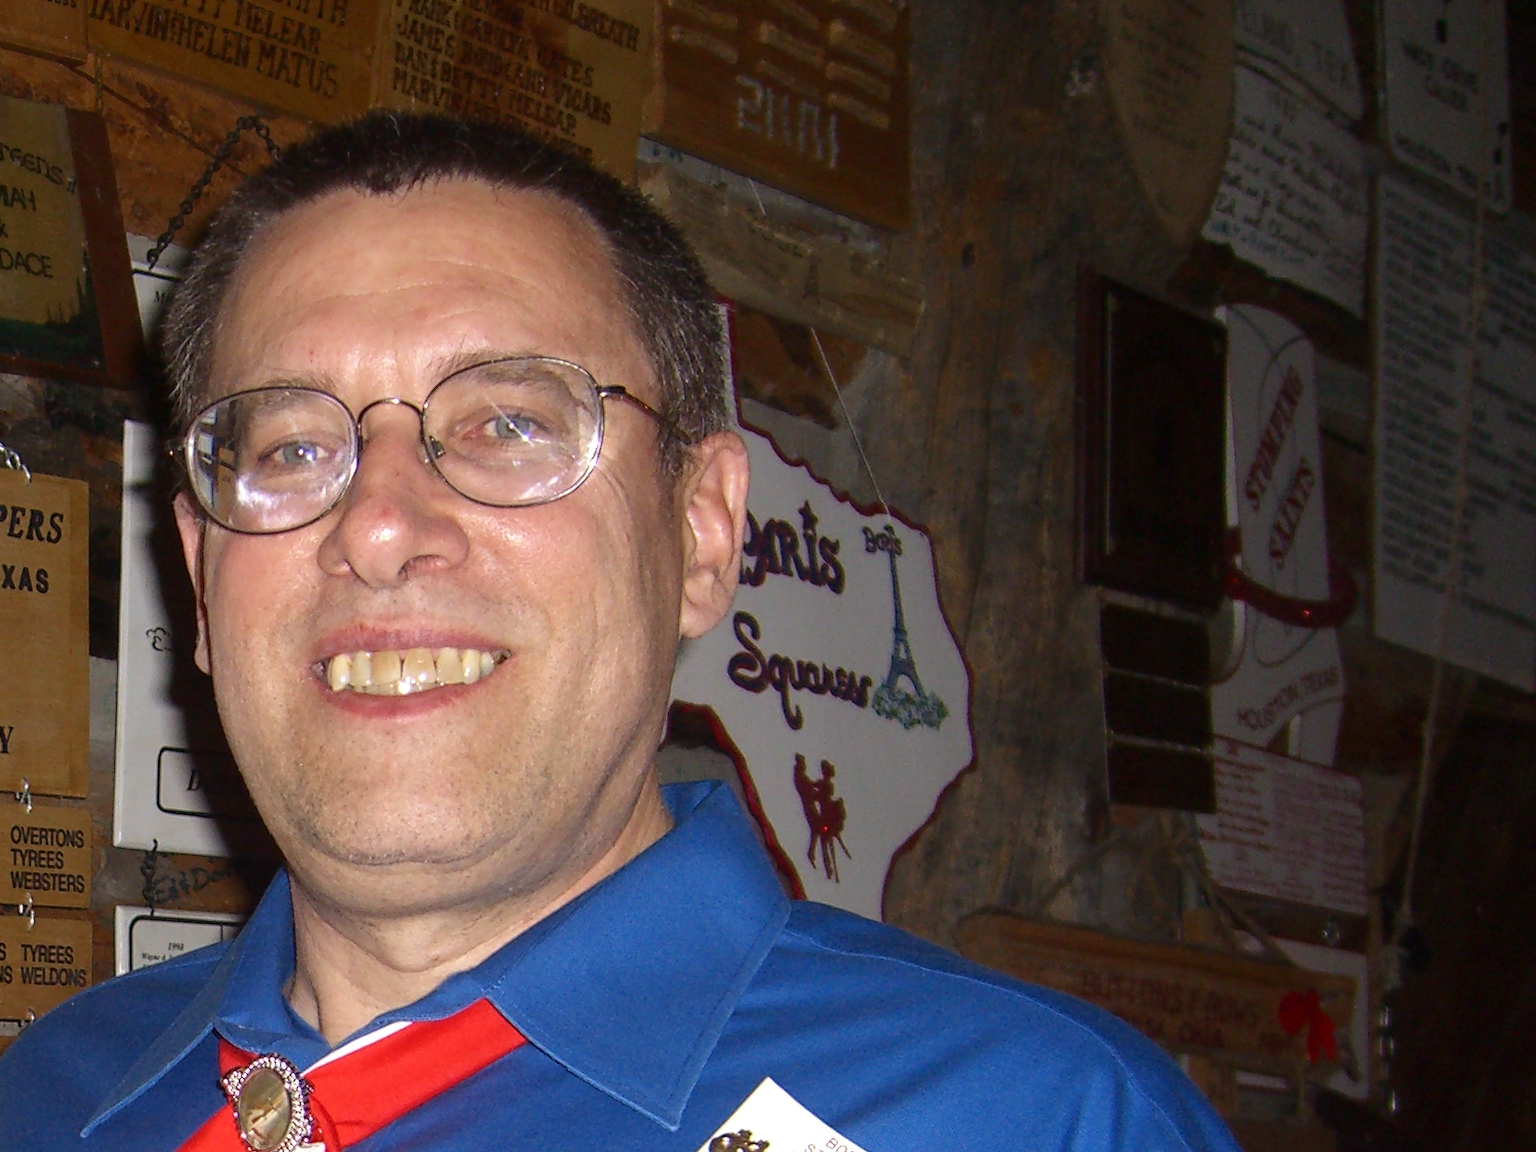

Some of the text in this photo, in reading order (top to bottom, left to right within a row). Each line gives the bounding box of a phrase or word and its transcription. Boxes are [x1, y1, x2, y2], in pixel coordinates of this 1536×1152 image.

[10, 825, 85, 849] OVERTONS
[10, 848, 65, 869] TYREES
[10, 870, 86, 893] WEBSTERS
[20, 943, 74, 965] TYREES
[20, 965, 88, 988] WELDONS
